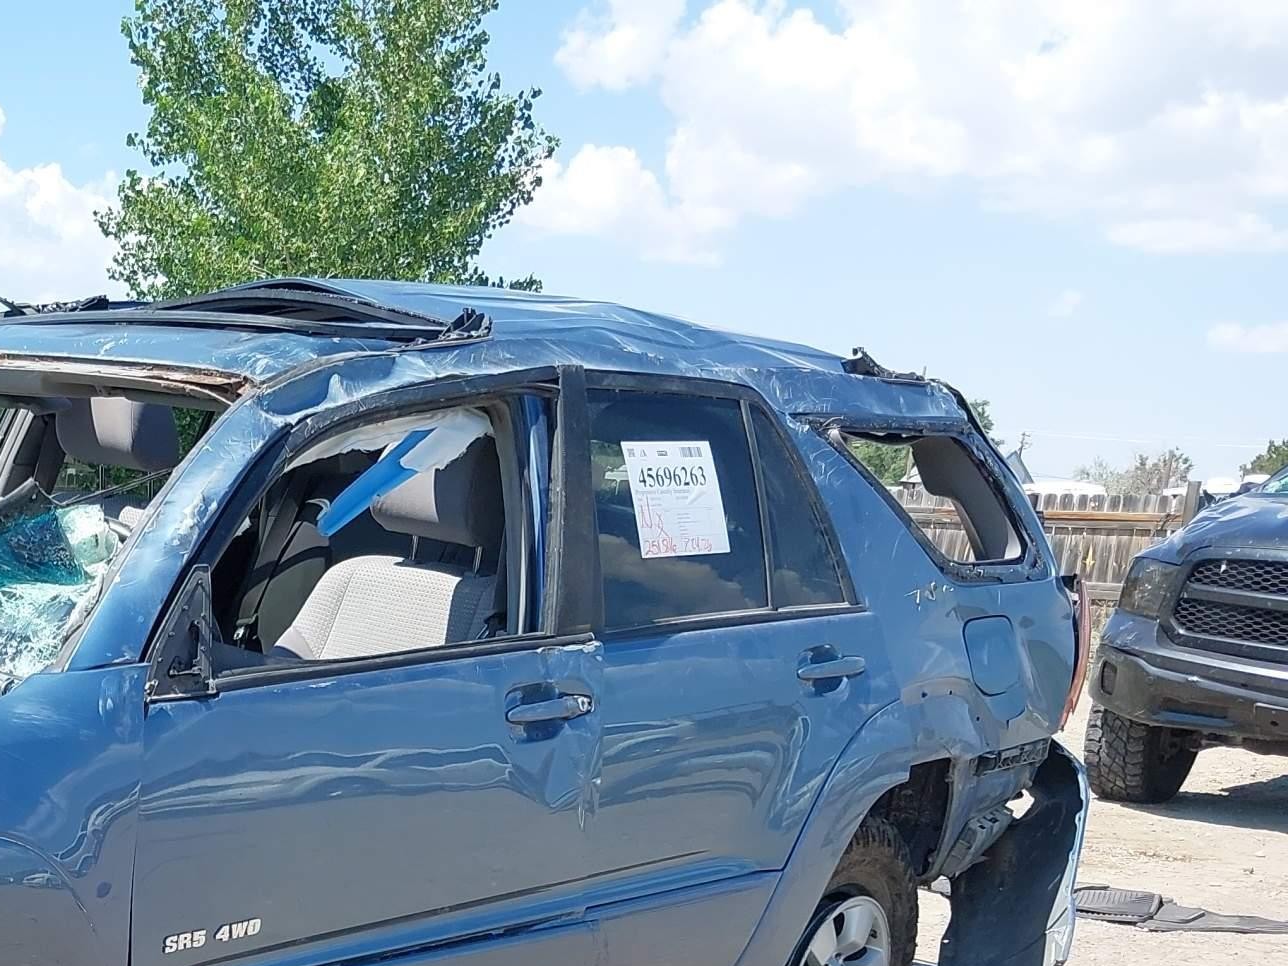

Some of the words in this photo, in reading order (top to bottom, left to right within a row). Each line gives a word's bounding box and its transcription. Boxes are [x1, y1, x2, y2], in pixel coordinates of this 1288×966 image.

[638, 465, 707, 488] 45696263
[162, 929, 207, 954] SR5
[214, 917, 262, 942] 4WD
